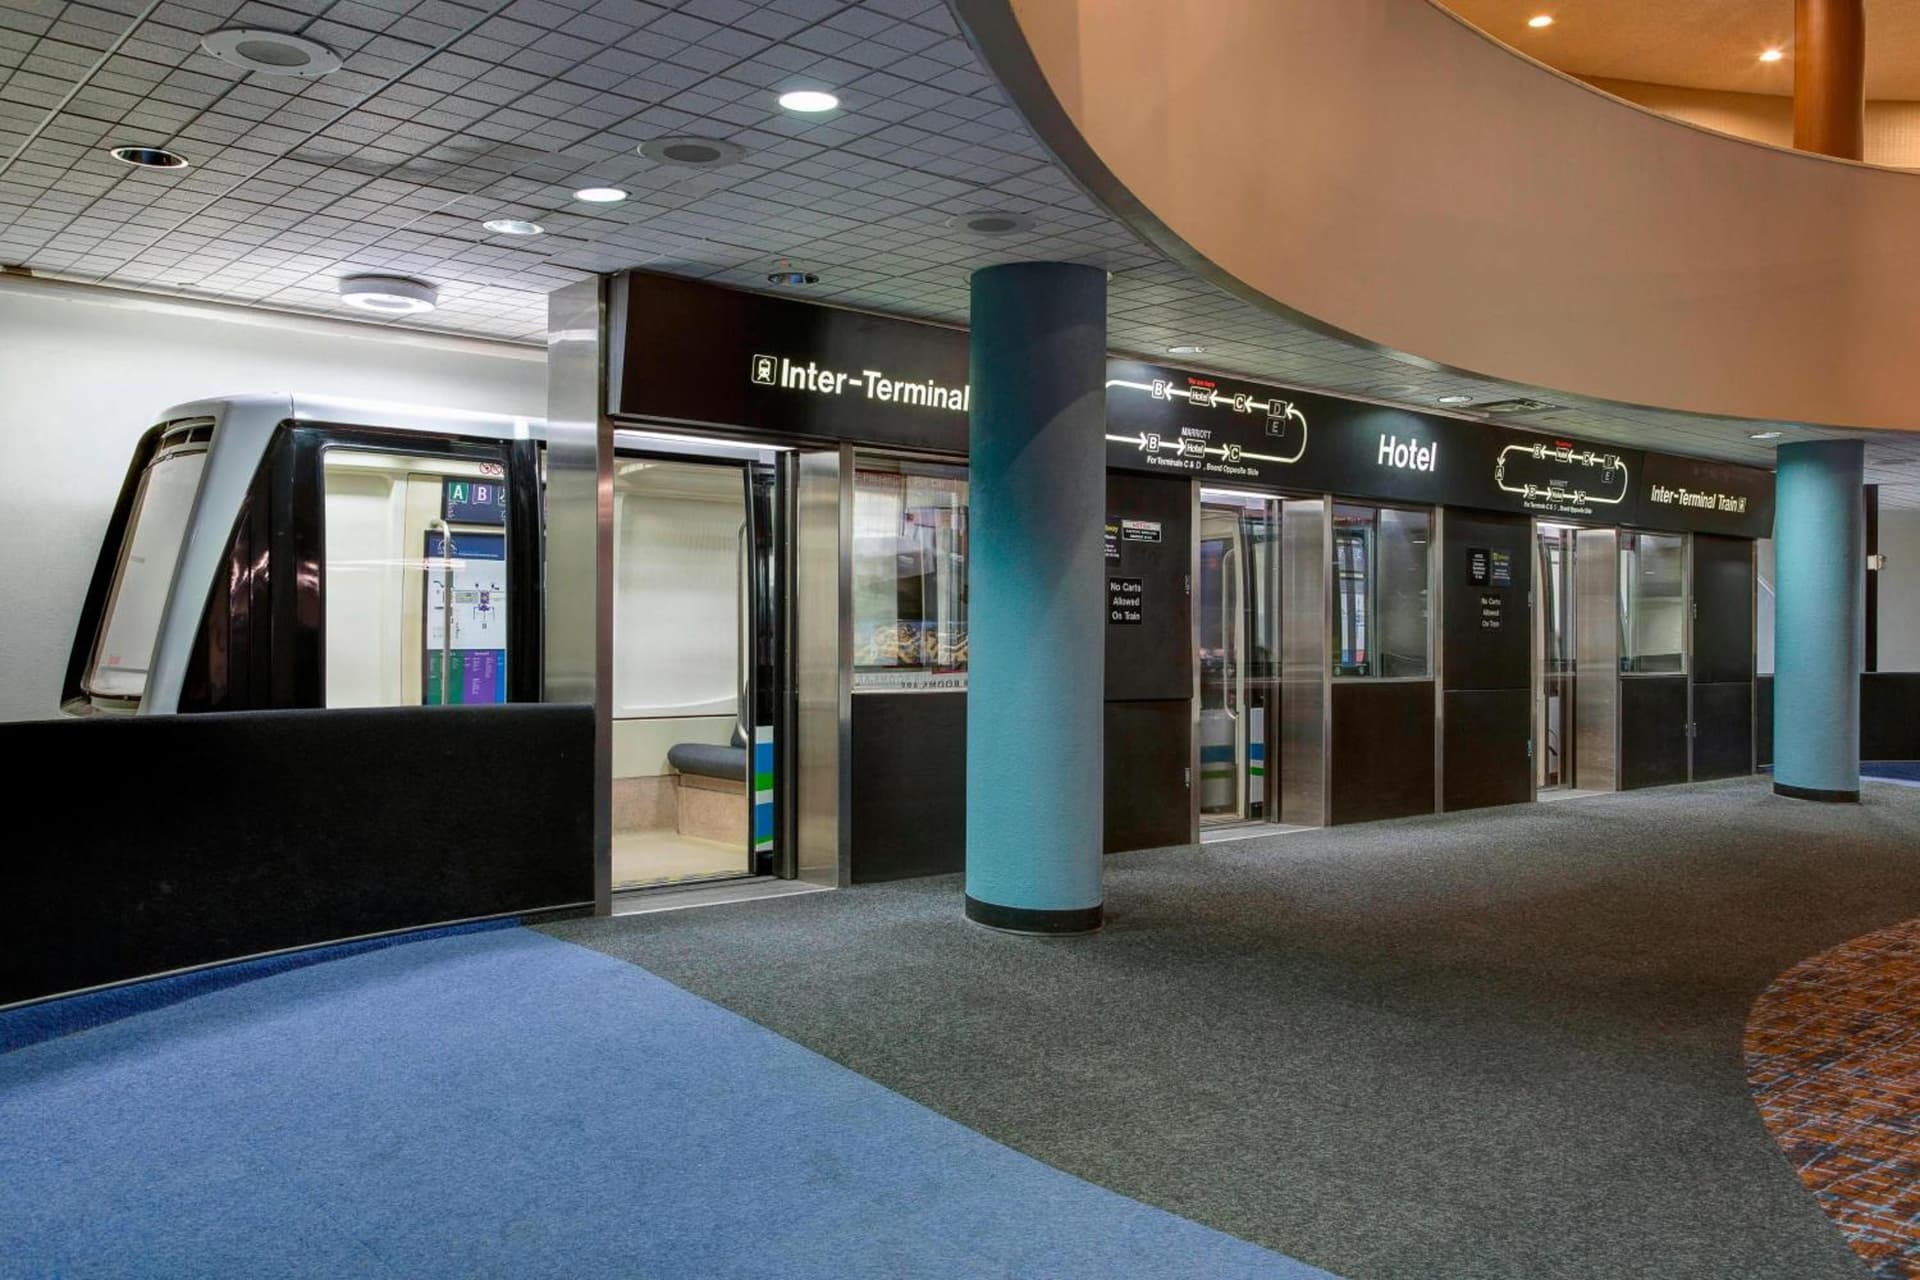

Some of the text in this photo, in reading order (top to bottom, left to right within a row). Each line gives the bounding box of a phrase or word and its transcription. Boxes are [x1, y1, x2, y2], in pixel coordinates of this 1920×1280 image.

[781, 358, 970, 412] Inter-Terminal
[1154, 383, 1163, 396] B
[1192, 390, 1209, 402] Hotel
[1235, 397, 1244, 409] C
[1273, 402, 1281, 415] D
[1272, 421, 1279, 432] E
[1181, 427, 1212, 440] MARRIOTT
[1149, 437, 1158, 449] B
[1187, 441, 1203, 453] Hotel
[1231, 448, 1239, 459] C
[1378, 434, 1438, 472] Hotel
[1146, 455, 1157, 465] For
[1183, 459, 1189, 468] C
[1195, 461, 1202, 470] D
[1497, 468, 1502, 477] A
[1605, 471, 1611, 480] E
[453, 484, 464, 500] A
[477, 486, 487, 501] B
[1650, 484, 1738, 512] Inter-Terminal Train
[1110, 582, 1141, 593] No Carts
[1112, 596, 1140, 607] Allowed
[1112, 610, 1141, 620] On Train
